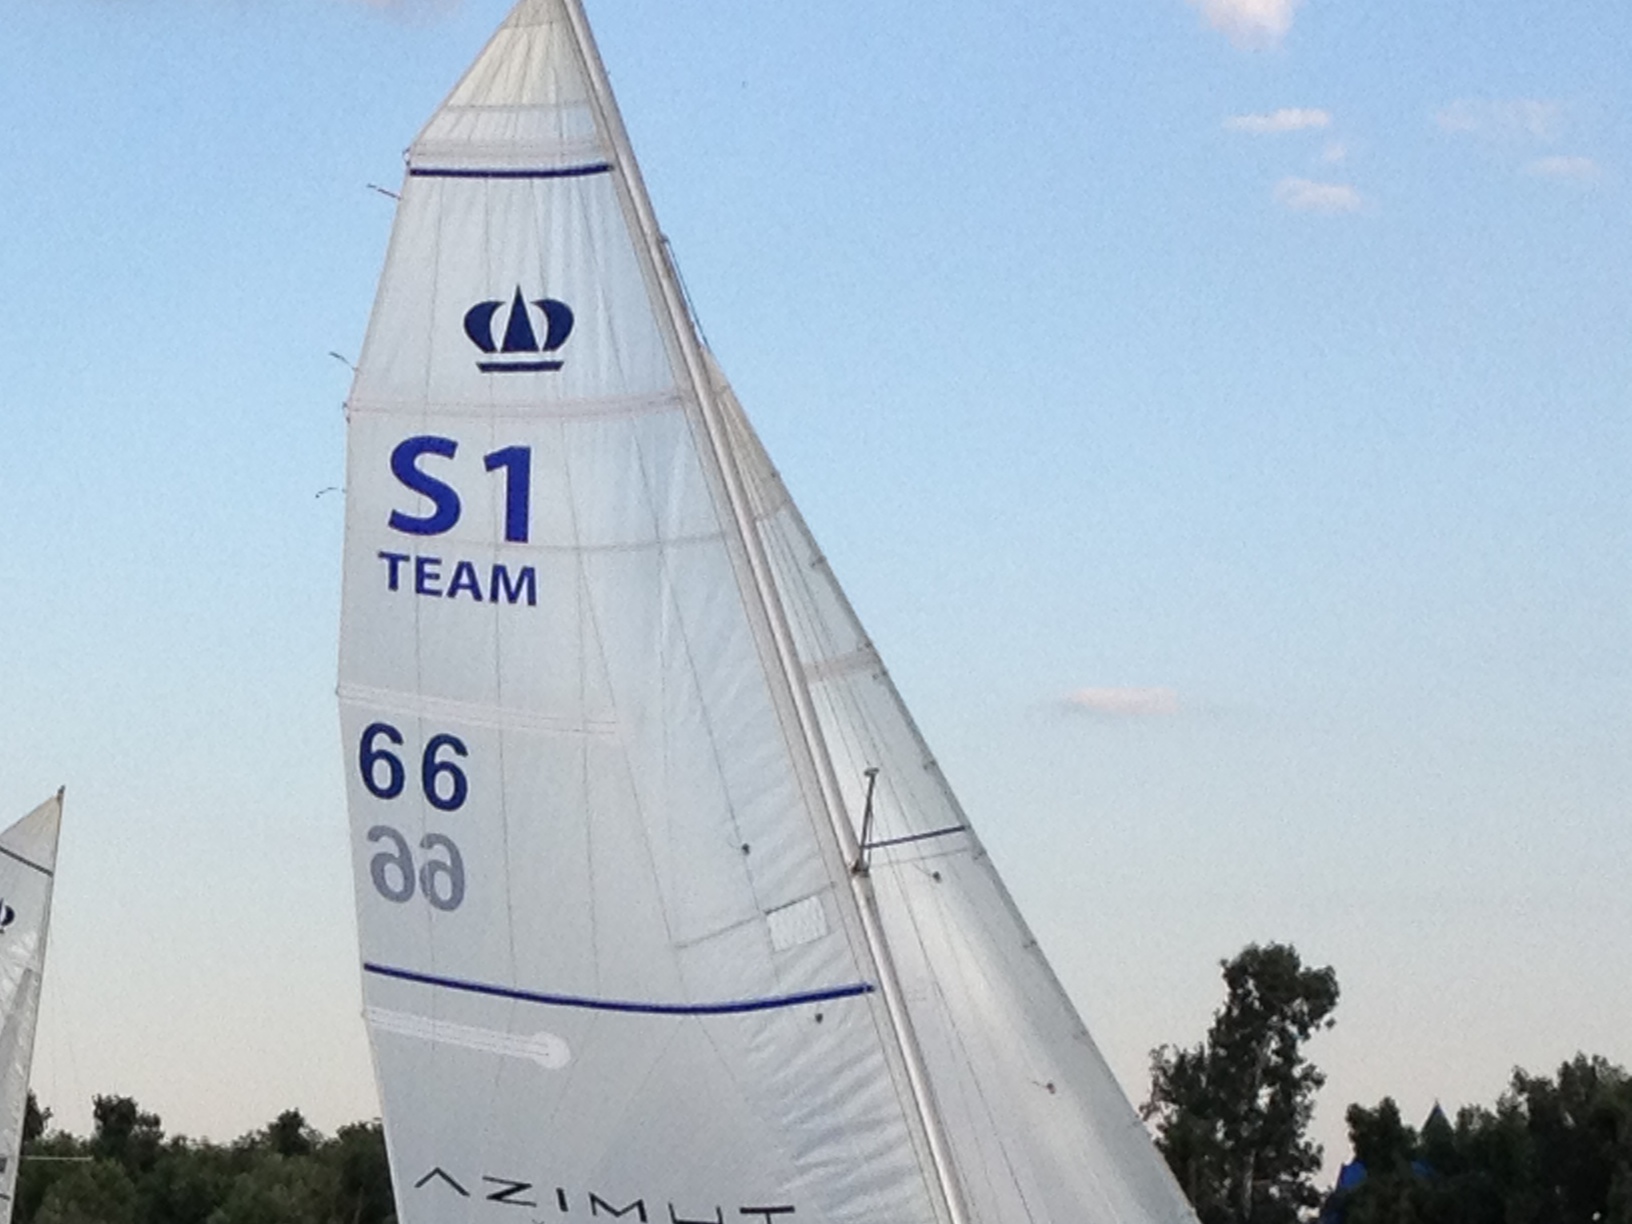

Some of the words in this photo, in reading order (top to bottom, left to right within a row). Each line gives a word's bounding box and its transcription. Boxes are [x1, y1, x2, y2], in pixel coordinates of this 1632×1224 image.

[387, 435, 531, 544] S1
[378, 551, 537, 606] TEAM
[359, 722, 468, 812] 66
